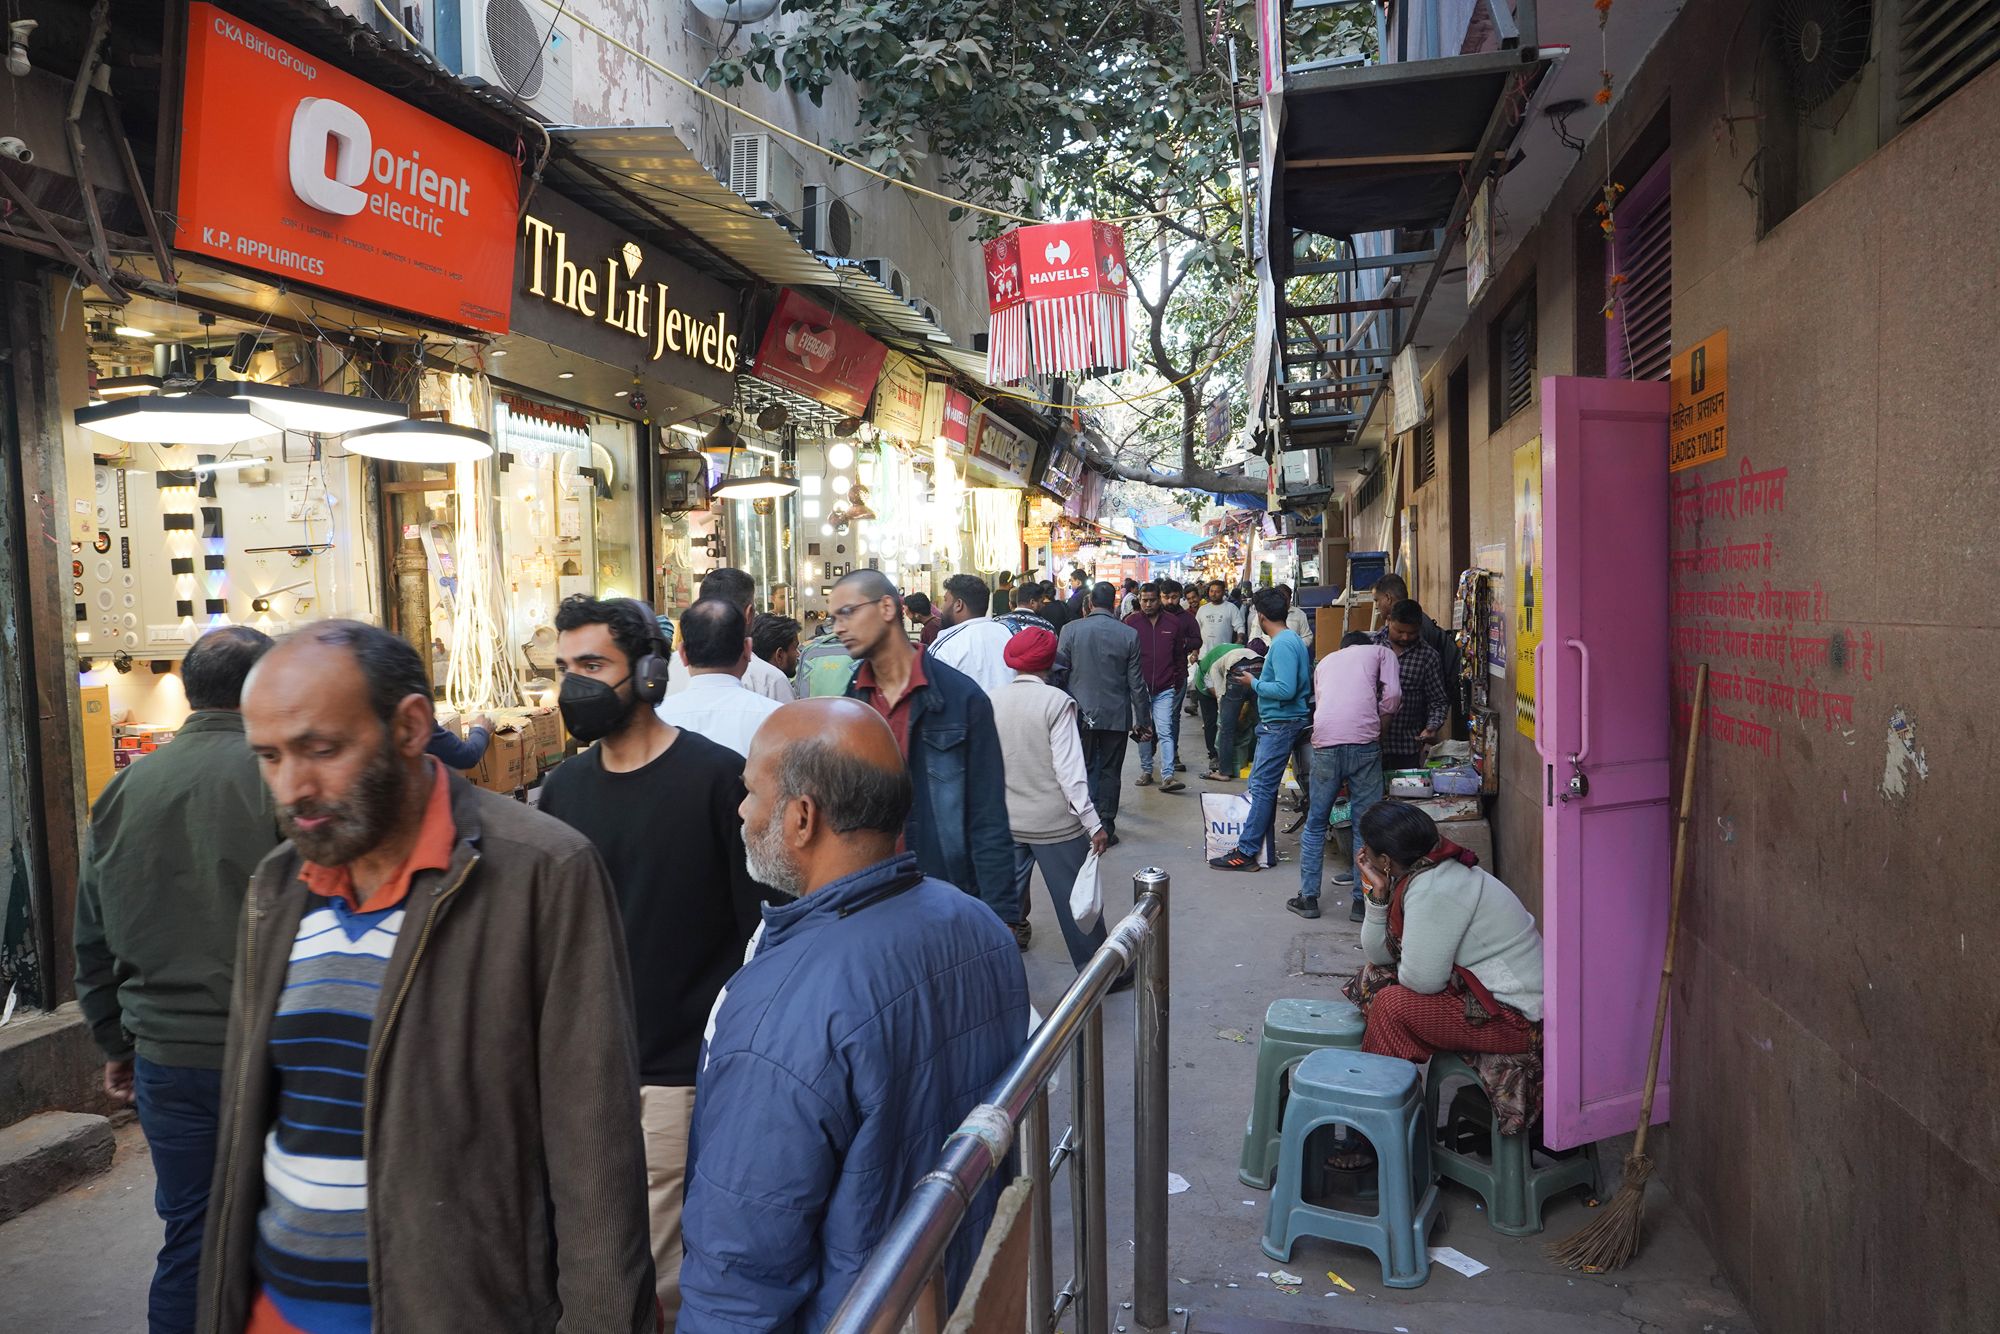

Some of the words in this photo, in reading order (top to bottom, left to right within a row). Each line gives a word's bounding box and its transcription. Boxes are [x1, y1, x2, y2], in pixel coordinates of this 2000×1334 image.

[214, 17, 243, 46] CKA
[245, 31, 277, 62] Birla
[278, 50, 317, 82] Group
[373, 149, 471, 217] orient
[370, 192, 443, 238] electric
[203, 227, 232, 251] K.P.
[236, 237, 324, 276] APPLIANCES
[526, 214, 597, 317] The
[605, 242, 649, 338] Lit
[653, 282, 738, 373] Jewels
[1029, 266, 1090, 285] HAVELLS
[798, 332, 833, 361] EVEREADY
[1672, 402, 1694, 432] महिला
[1697, 390, 1725, 421] प्रसाधन
[1671, 437, 1696, 465] LADIES
[1698, 426, 1726, 457] TOILET
[1739, 456, 1788, 518] निगम
